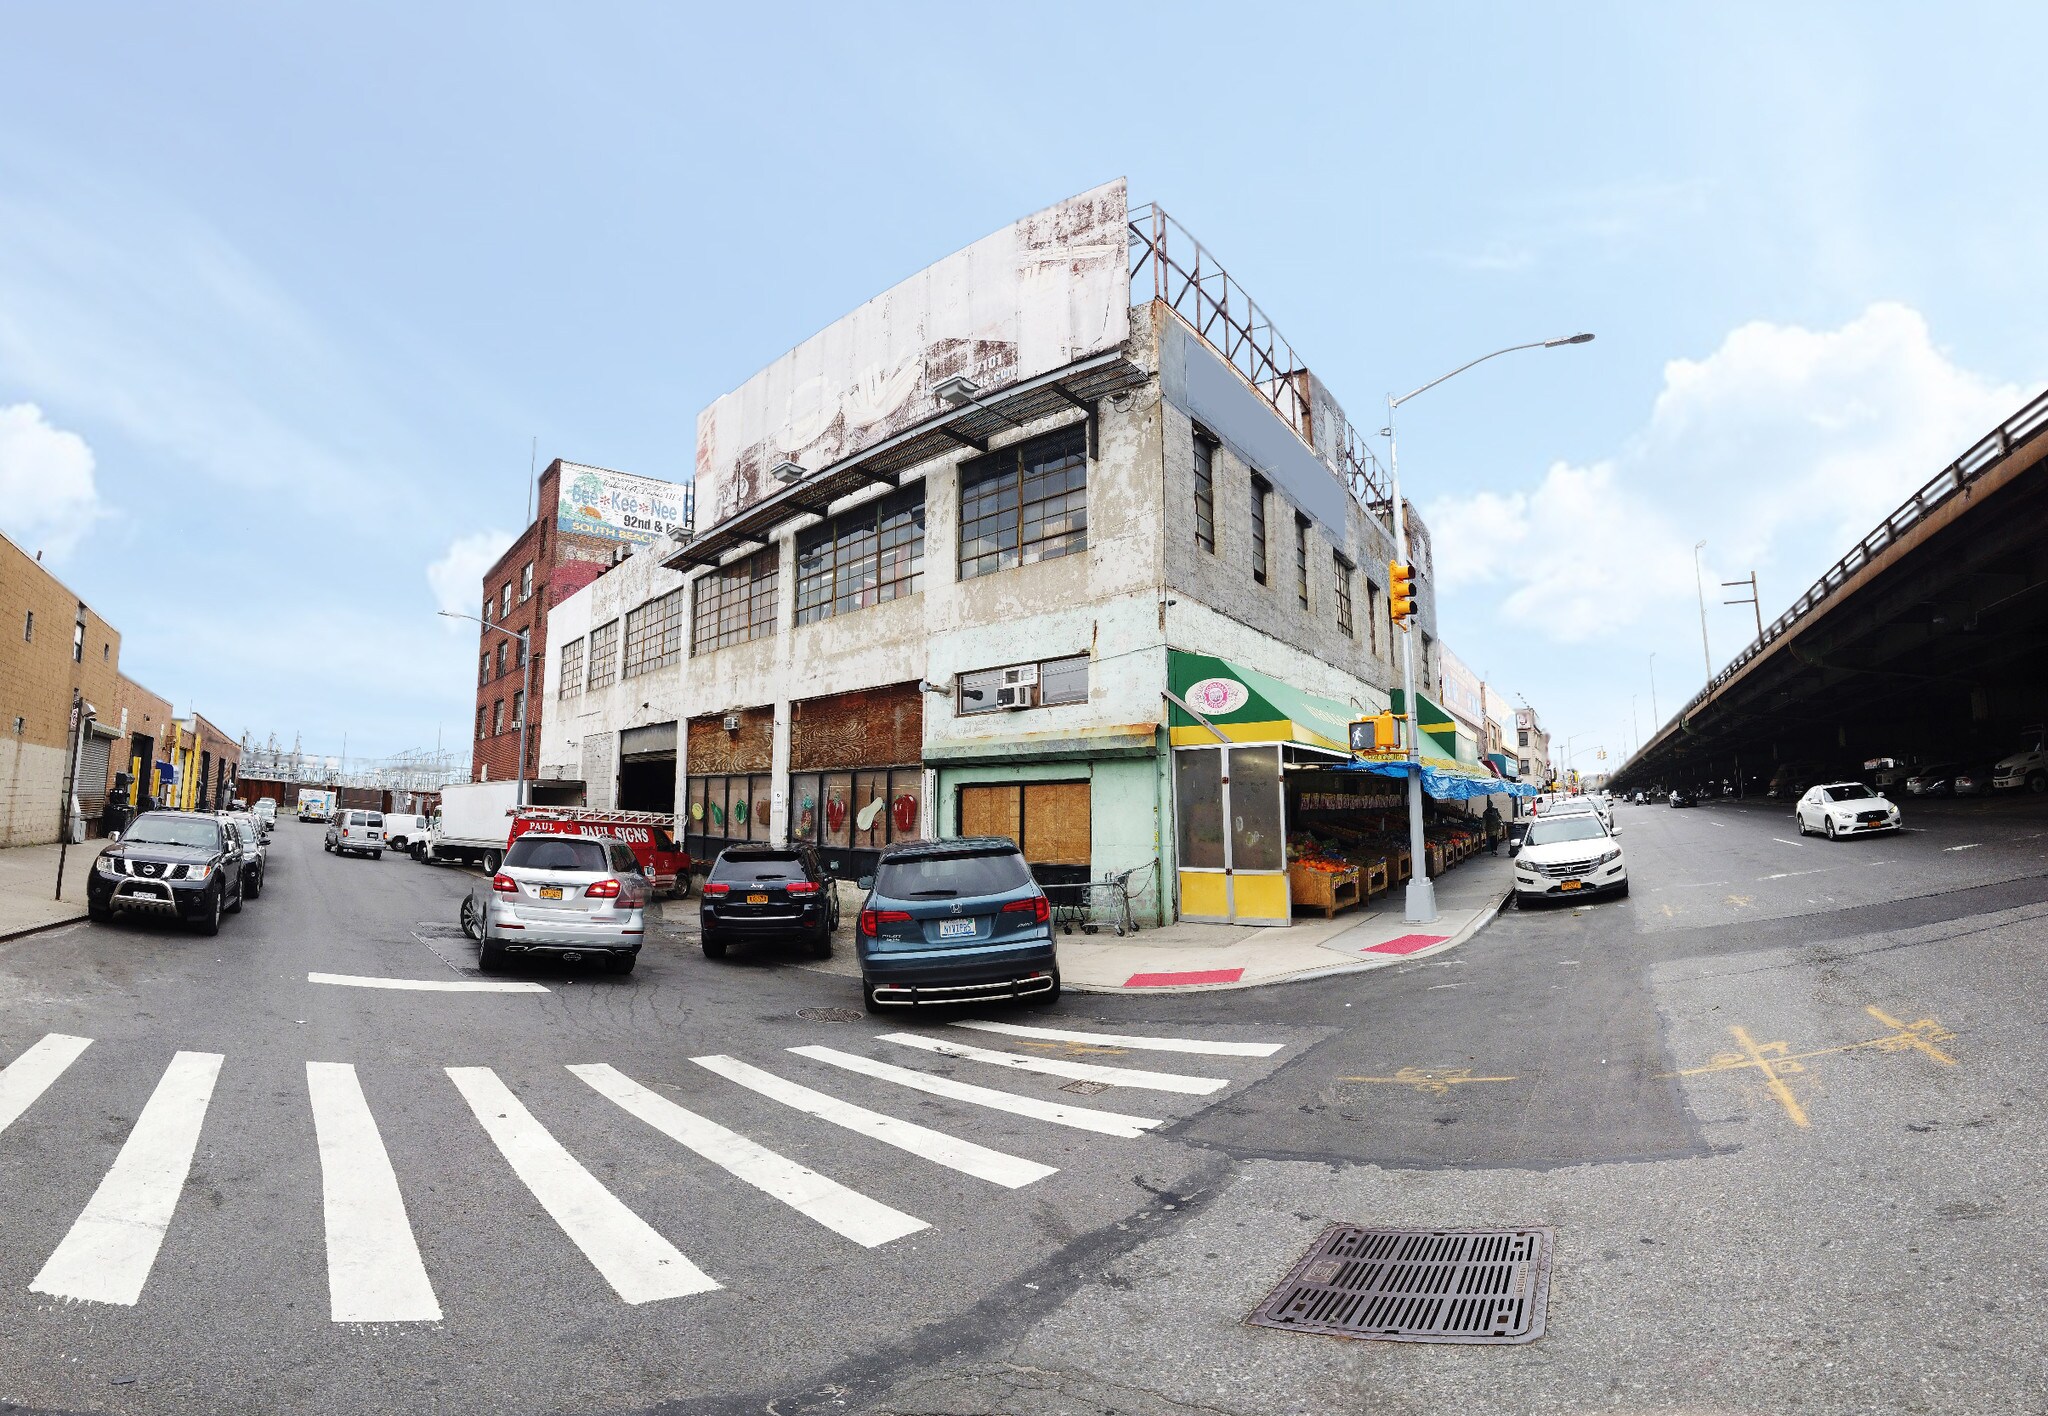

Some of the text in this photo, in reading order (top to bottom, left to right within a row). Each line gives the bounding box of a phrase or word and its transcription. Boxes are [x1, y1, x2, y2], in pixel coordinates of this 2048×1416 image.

[572, 484, 599, 505] Bee
[611, 490, 638, 513] Kee
[650, 499, 678, 520] Nee
[572, 521, 616, 537] SOUTH
[623, 514, 651, 531] 92nd
[654, 520, 664, 533] &
[529, 821, 555, 831] PAUL
[615, 826, 649, 843] SIGNS
